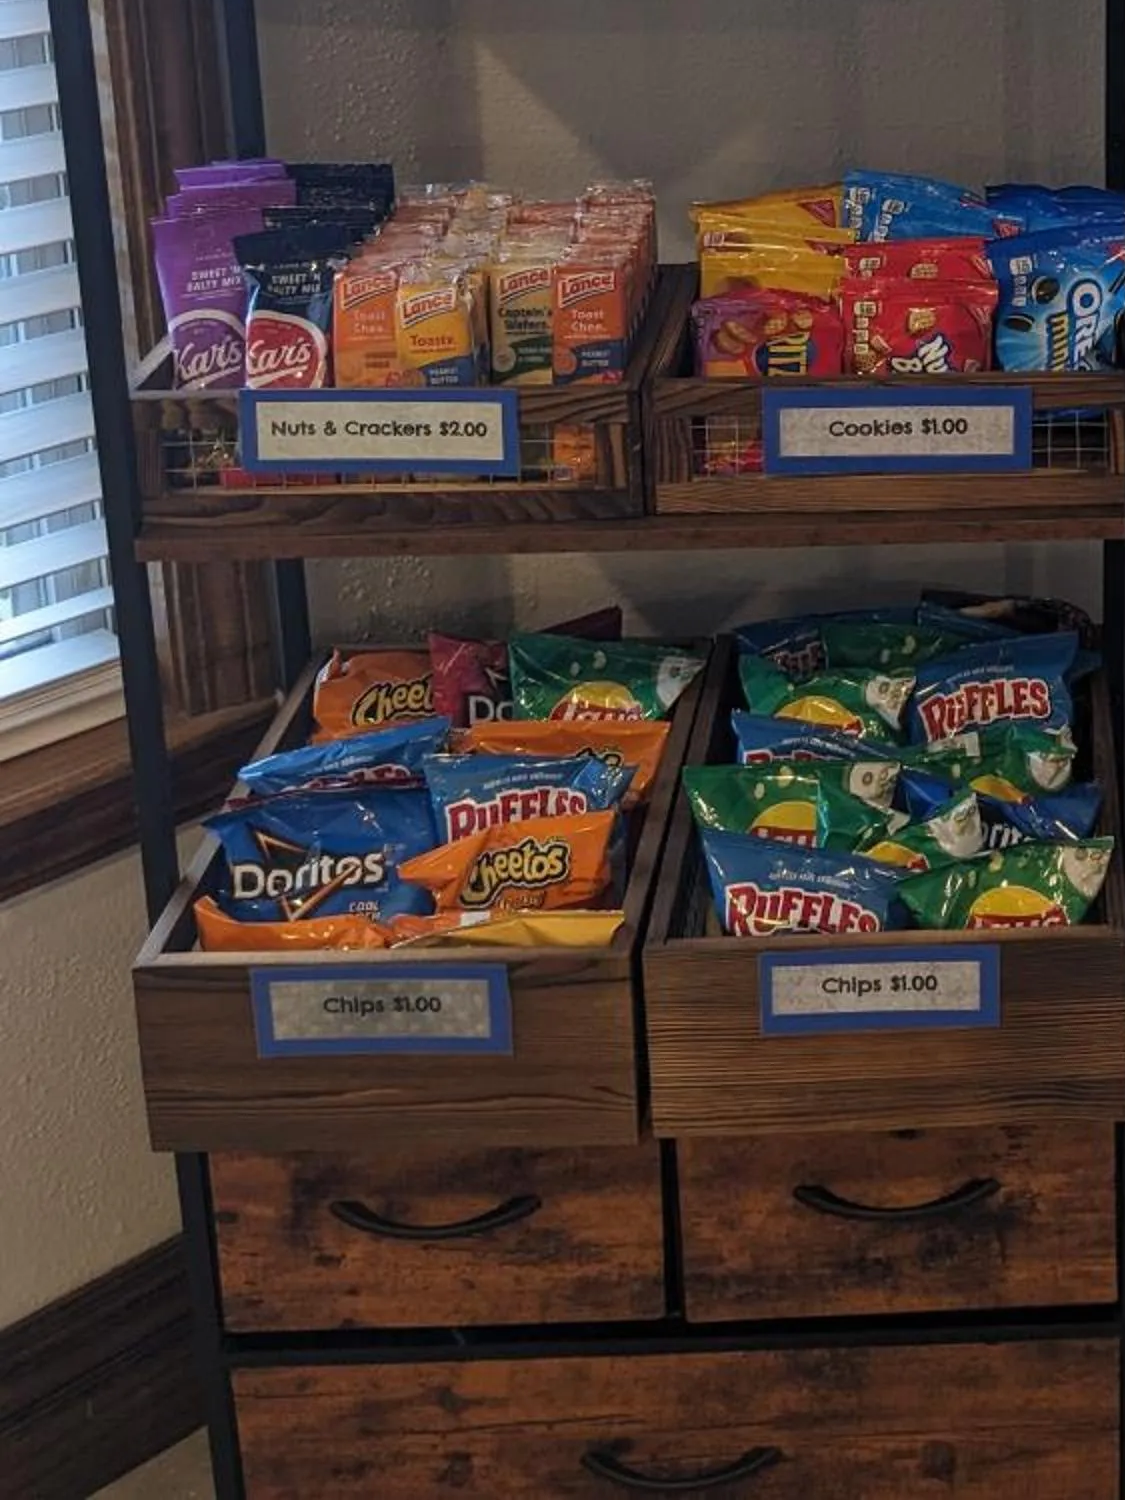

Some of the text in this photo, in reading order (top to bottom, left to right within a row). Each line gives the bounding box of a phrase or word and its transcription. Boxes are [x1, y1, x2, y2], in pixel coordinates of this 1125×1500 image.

[500, 268, 550, 294] Lance
[561, 275, 614, 303] Lance
[402, 293, 454, 319] Lance
[270, 419, 489, 439] Nuts & Crackers $2.00
[828, 417, 968, 439] Cookies $1.00
[918, 677, 1051, 743] RUFFLES
[232, 852, 384, 899] Doritos
[461, 840, 567, 905] Cheetos
[822, 974, 939, 995] Chips $1.00
[322, 995, 442, 1017] Chips $1.00
